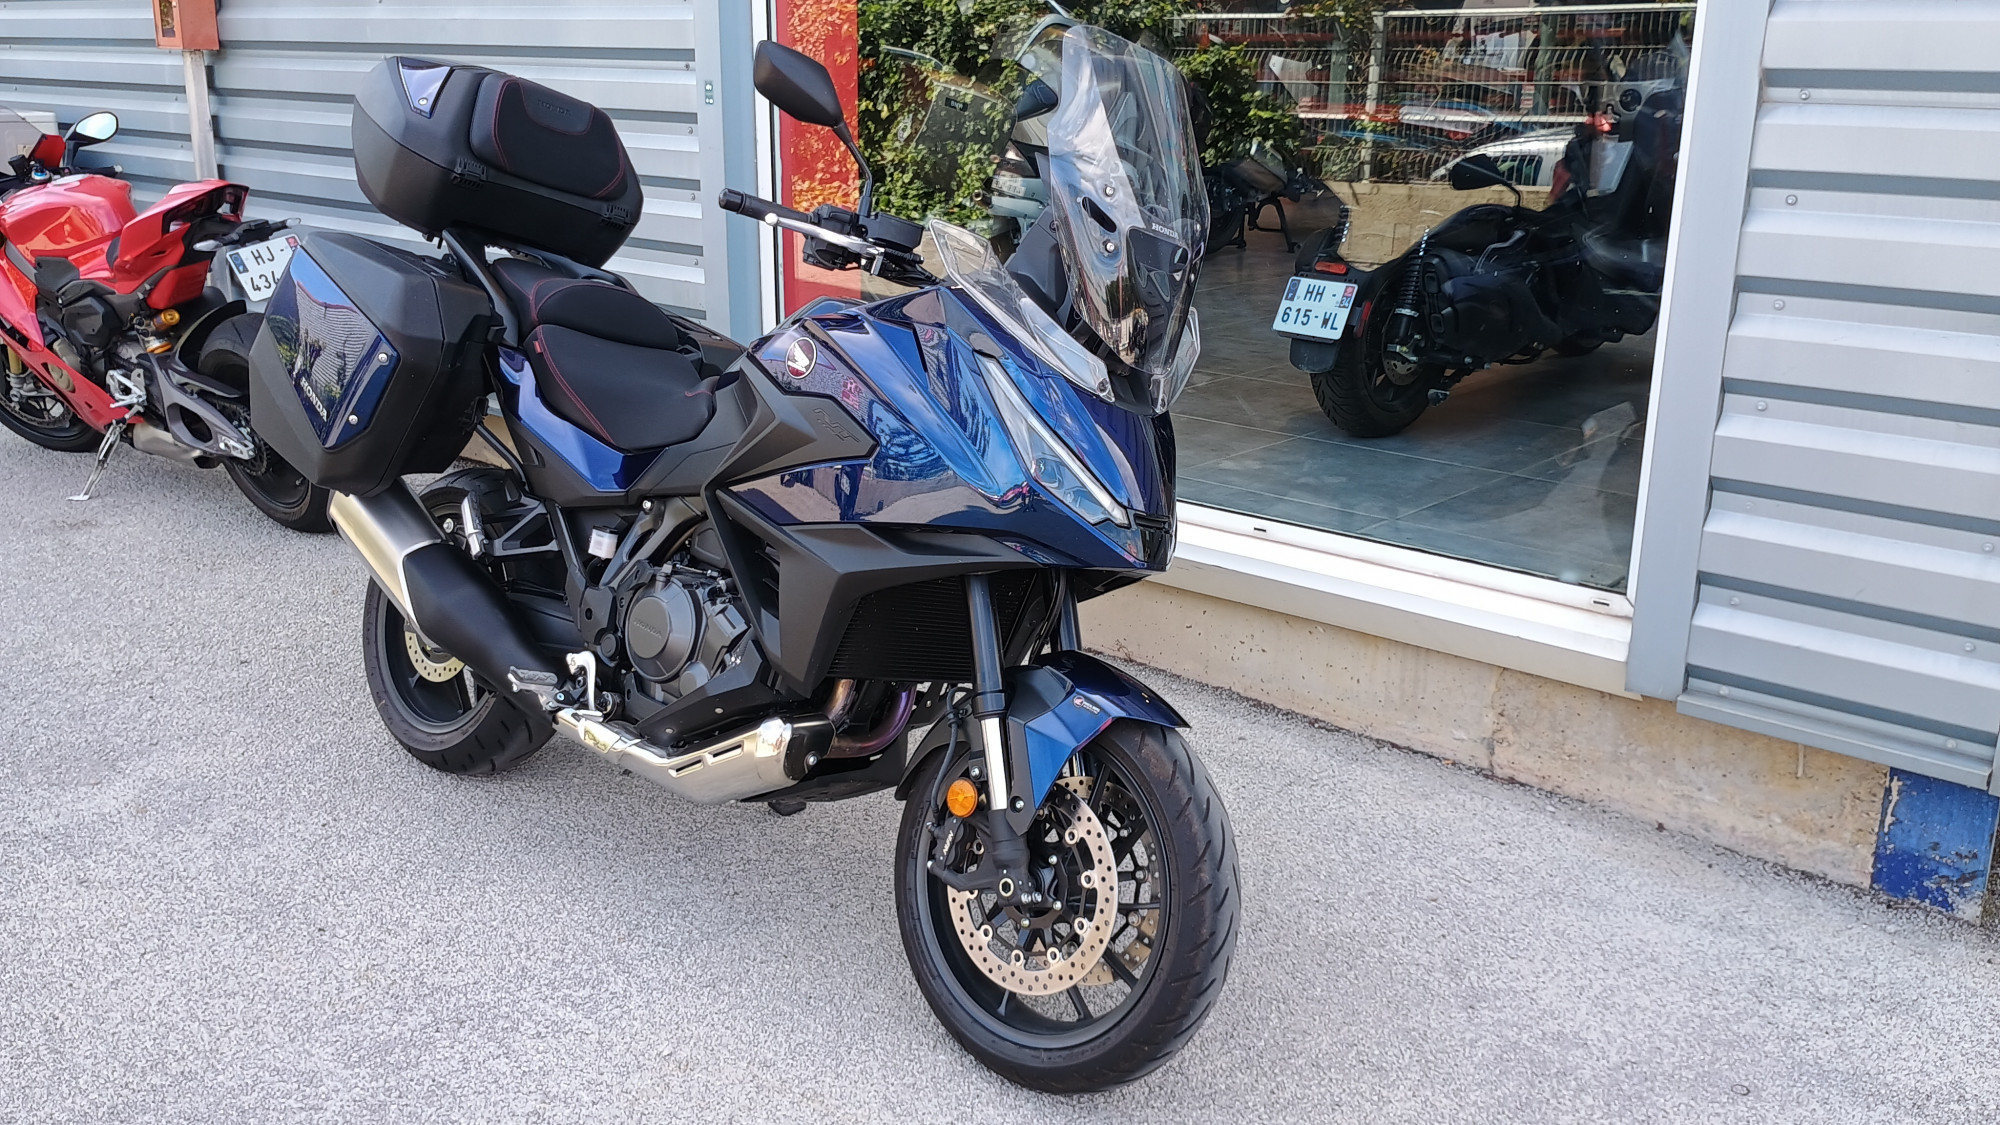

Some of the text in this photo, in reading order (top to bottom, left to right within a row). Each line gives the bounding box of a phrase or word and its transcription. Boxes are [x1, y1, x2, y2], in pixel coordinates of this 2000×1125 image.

[1151, 222, 1179, 240] HONDA
[1281, 306, 1338, 331] 615-WL
[300, 376, 328, 422] HONDA
